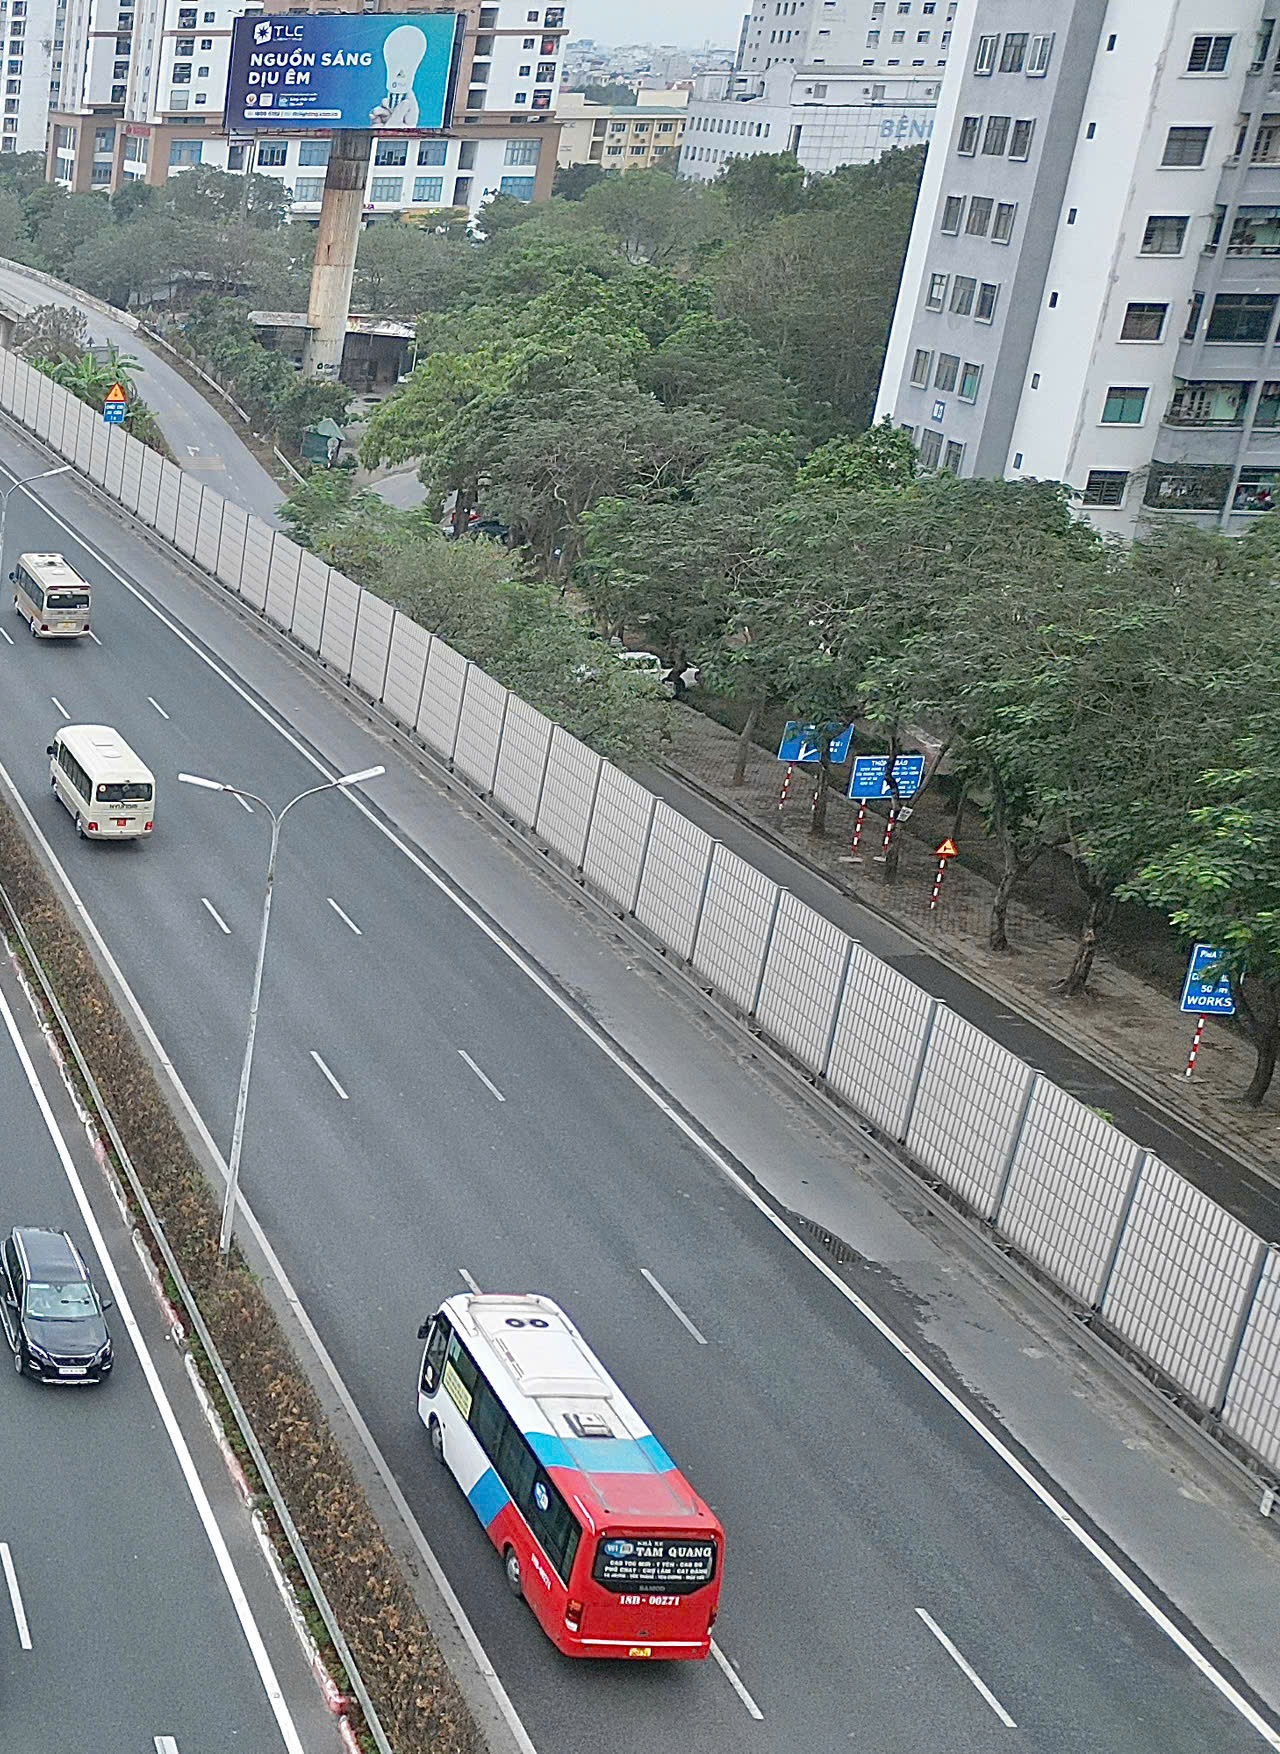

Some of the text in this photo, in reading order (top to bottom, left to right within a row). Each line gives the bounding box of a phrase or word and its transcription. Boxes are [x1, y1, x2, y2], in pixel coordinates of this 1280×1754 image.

[274, 26, 304, 37] TLC
[321, 50, 372, 67] SÁNG
[248, 68, 311, 88] DỊU ÊM
[1187, 996, 1232, 1007] WORKS
[636, 1547, 663, 1557] TAM
[668, 1547, 712, 1558] QUANG
